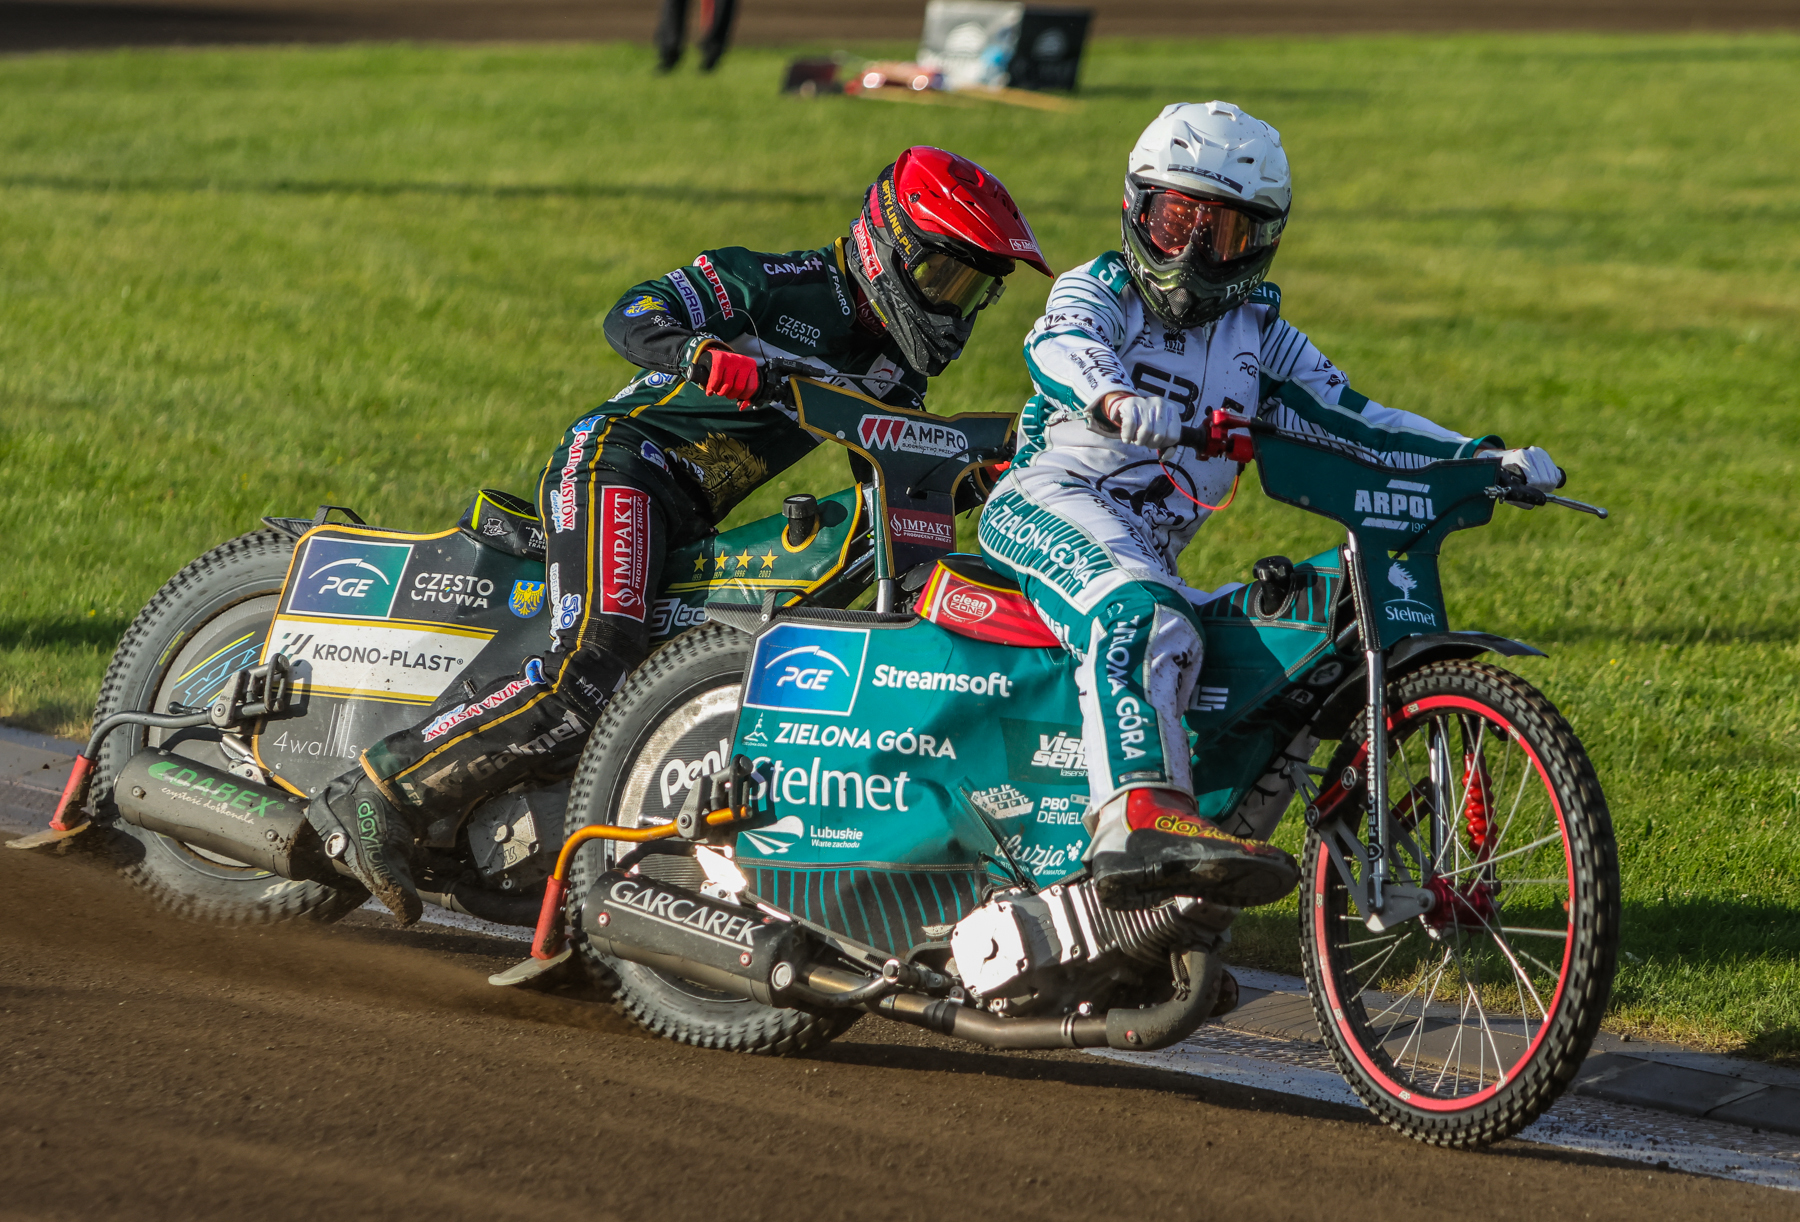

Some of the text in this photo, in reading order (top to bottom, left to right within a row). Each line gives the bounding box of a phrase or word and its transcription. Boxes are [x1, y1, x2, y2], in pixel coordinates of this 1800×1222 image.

[1178, 165, 1231, 185] REAL
[670, 270, 704, 327] OLARIS
[832, 275, 851, 316] FAKRO
[902, 424, 967, 451] AMPRO
[1354, 489, 1437, 521] ARPOL
[612, 492, 634, 587] IMPAKT
[902, 518, 952, 536] IMPAKT
[634, 496, 645, 589] PRODUCENT ZNICZY
[318, 576, 374, 598] PGE
[758, 570, 772, 578] 2003
[950, 601, 985, 617] ZONE
[952, 593, 988, 609] clean
[1384, 606, 1437, 627] Stelmet
[777, 666, 834, 691] PGE
[872, 664, 1013, 698] Streamsoft
[774, 722, 957, 760] ZIELONA GÓRA
[1115, 696, 1147, 761] GÓRA
[1366, 704, 1376, 838] FELGENHAUER
[749, 756, 911, 813] Stelmet
[1040, 796, 1070, 811] PBO
[1036, 810, 1082, 825] DEWEL
[810, 824, 864, 840] Lubuskie
[811, 838, 861, 849] Warte zachodu
[609, 879, 766, 947] GARCAREK
